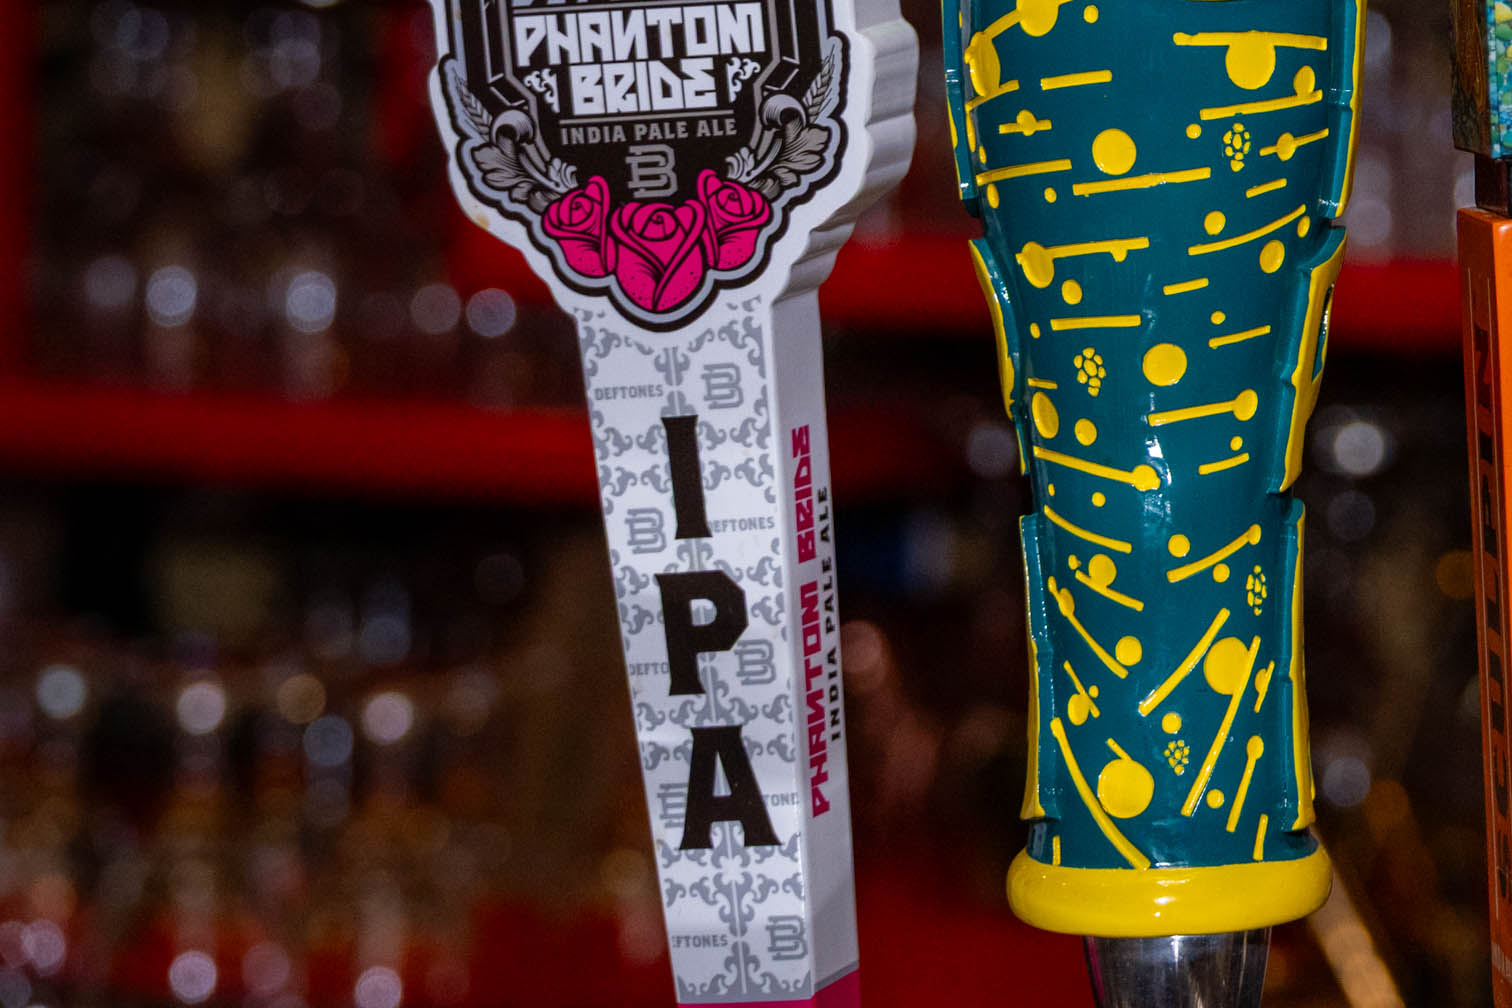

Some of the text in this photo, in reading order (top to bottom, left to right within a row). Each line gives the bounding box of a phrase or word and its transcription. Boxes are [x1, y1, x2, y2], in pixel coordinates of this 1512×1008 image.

[512, 2, 768, 67] PHANTOM
[570, 56, 719, 117] BRIDE
[560, 117, 738, 146] INDIA PALE ALE
[594, 384, 664, 401] DEFTONES
[791, 424, 816, 565] BRIDE
[817, 485, 841, 742] INDIA PALE ALE
